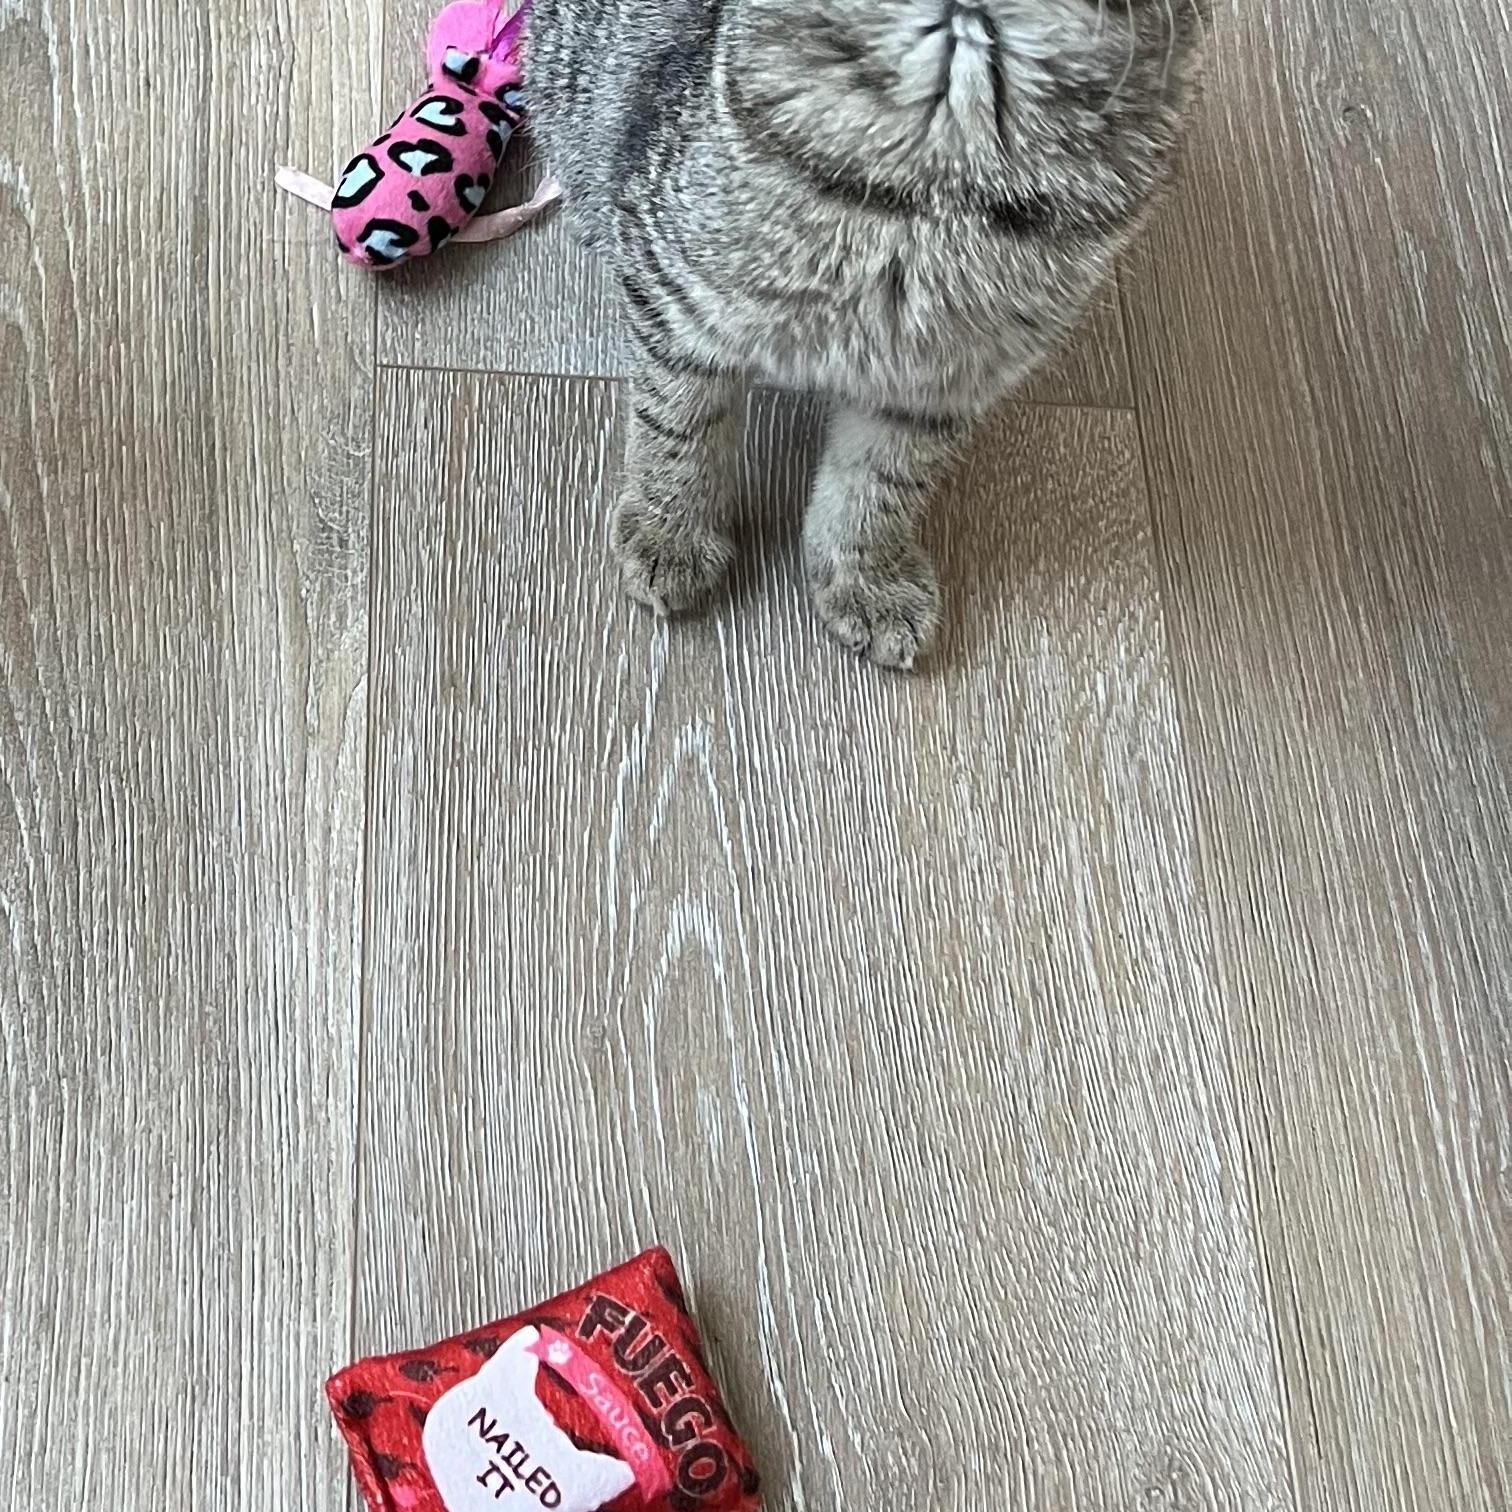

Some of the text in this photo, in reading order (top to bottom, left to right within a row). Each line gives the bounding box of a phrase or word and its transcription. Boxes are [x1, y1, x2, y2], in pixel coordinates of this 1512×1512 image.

[576, 1292, 730, 1498] FUEGO
[579, 1371, 649, 1462] Sauce
[467, 1407, 562, 1509] NAILED
[476, 1460, 515, 1499] IT
